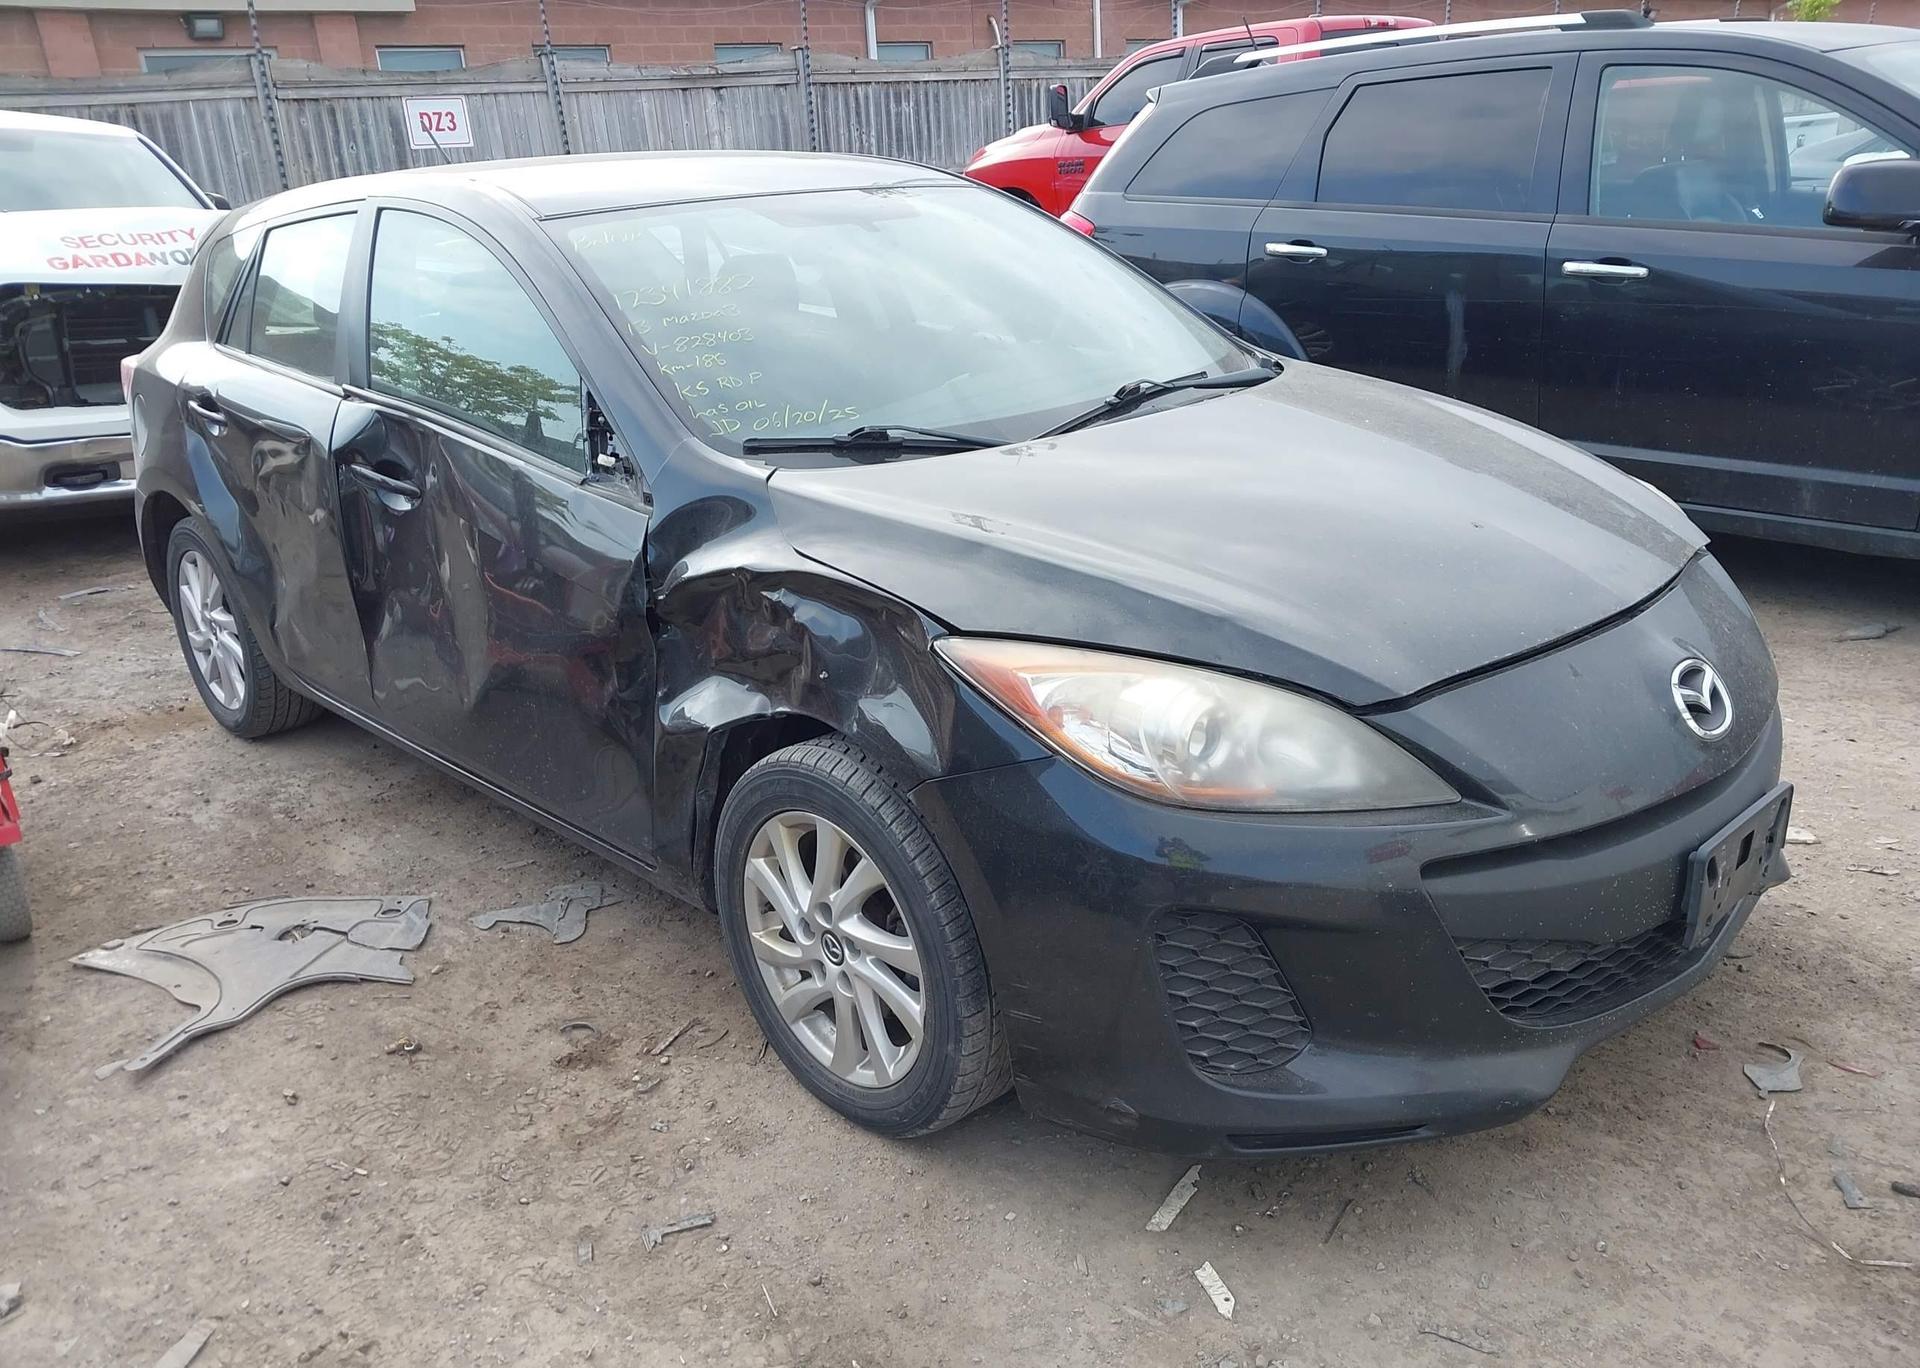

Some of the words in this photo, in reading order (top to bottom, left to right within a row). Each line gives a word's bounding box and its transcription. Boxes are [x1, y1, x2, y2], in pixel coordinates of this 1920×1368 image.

[418, 111, 457, 133] DZ3
[60, 227, 196, 250] SECURITY
[752, 399, 861, 432] 06/20/25
